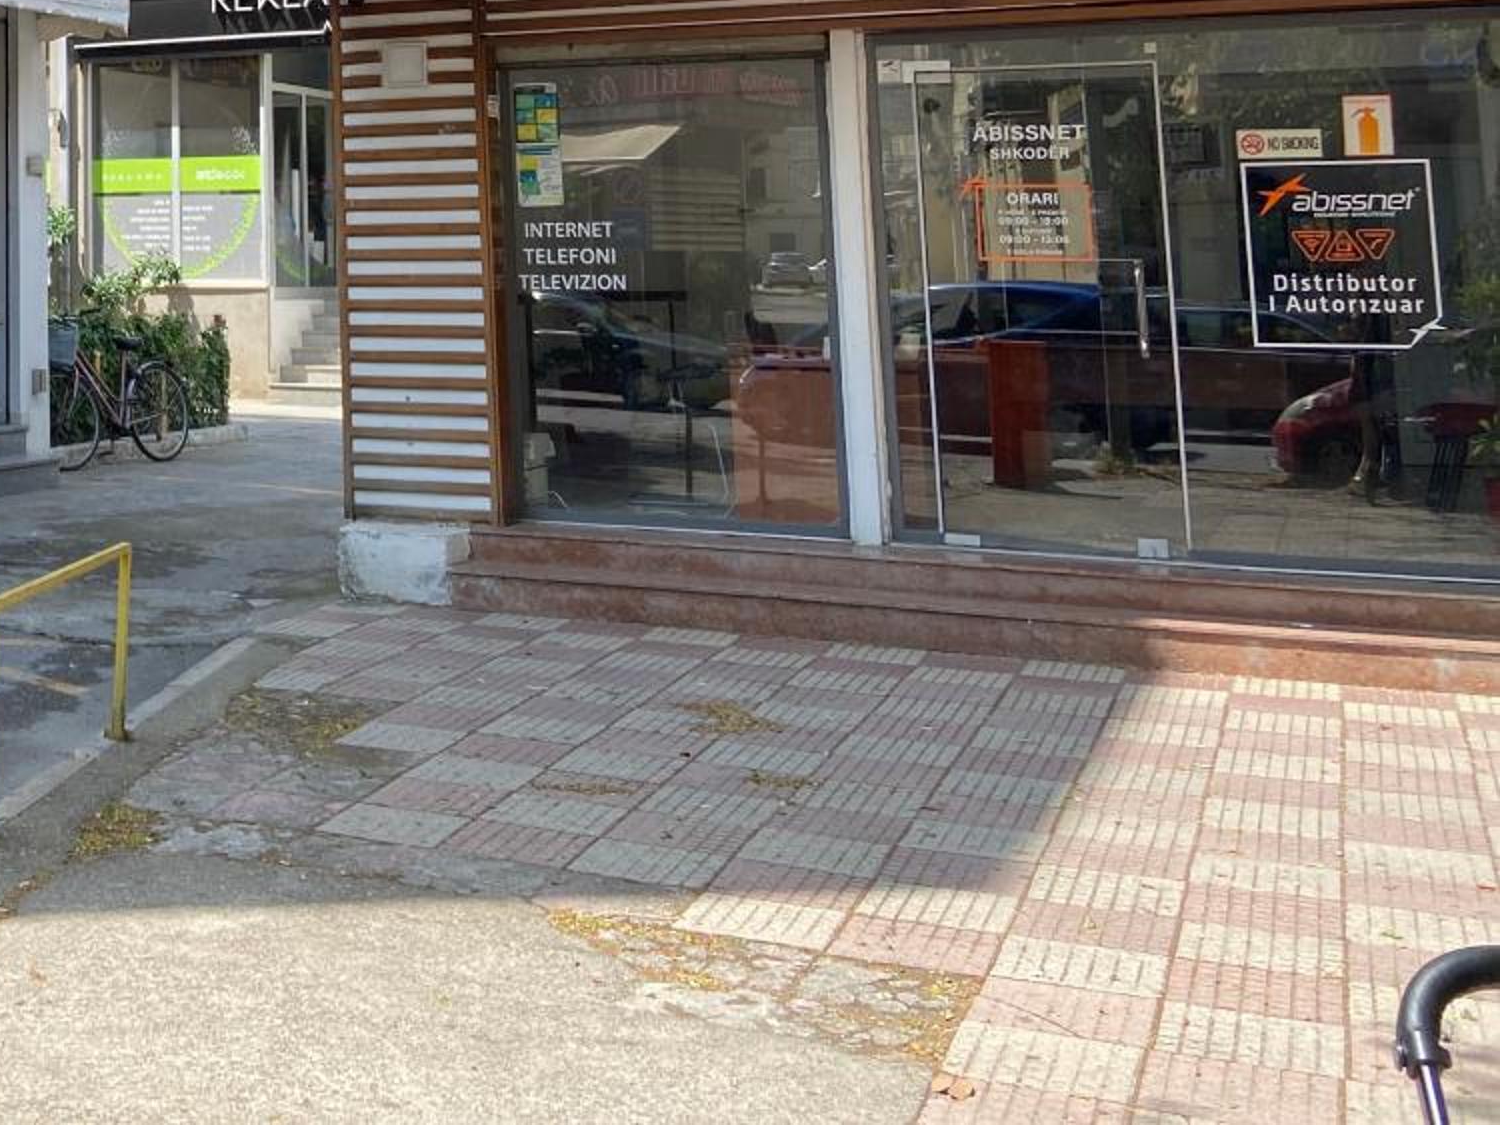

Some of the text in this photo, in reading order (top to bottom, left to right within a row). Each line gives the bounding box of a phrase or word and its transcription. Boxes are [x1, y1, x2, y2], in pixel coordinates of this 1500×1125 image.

[973, 123, 1086, 142] ABISSNET
[1291, 188, 1416, 213] abissnet
[524, 221, 613, 238] INTERNET
[523, 248, 617, 265] TELEFONI
[518, 274, 627, 291] TELEVIZION
[1273, 272, 1417, 292] Distributor
[1285, 295, 1425, 313] Autorizuar
